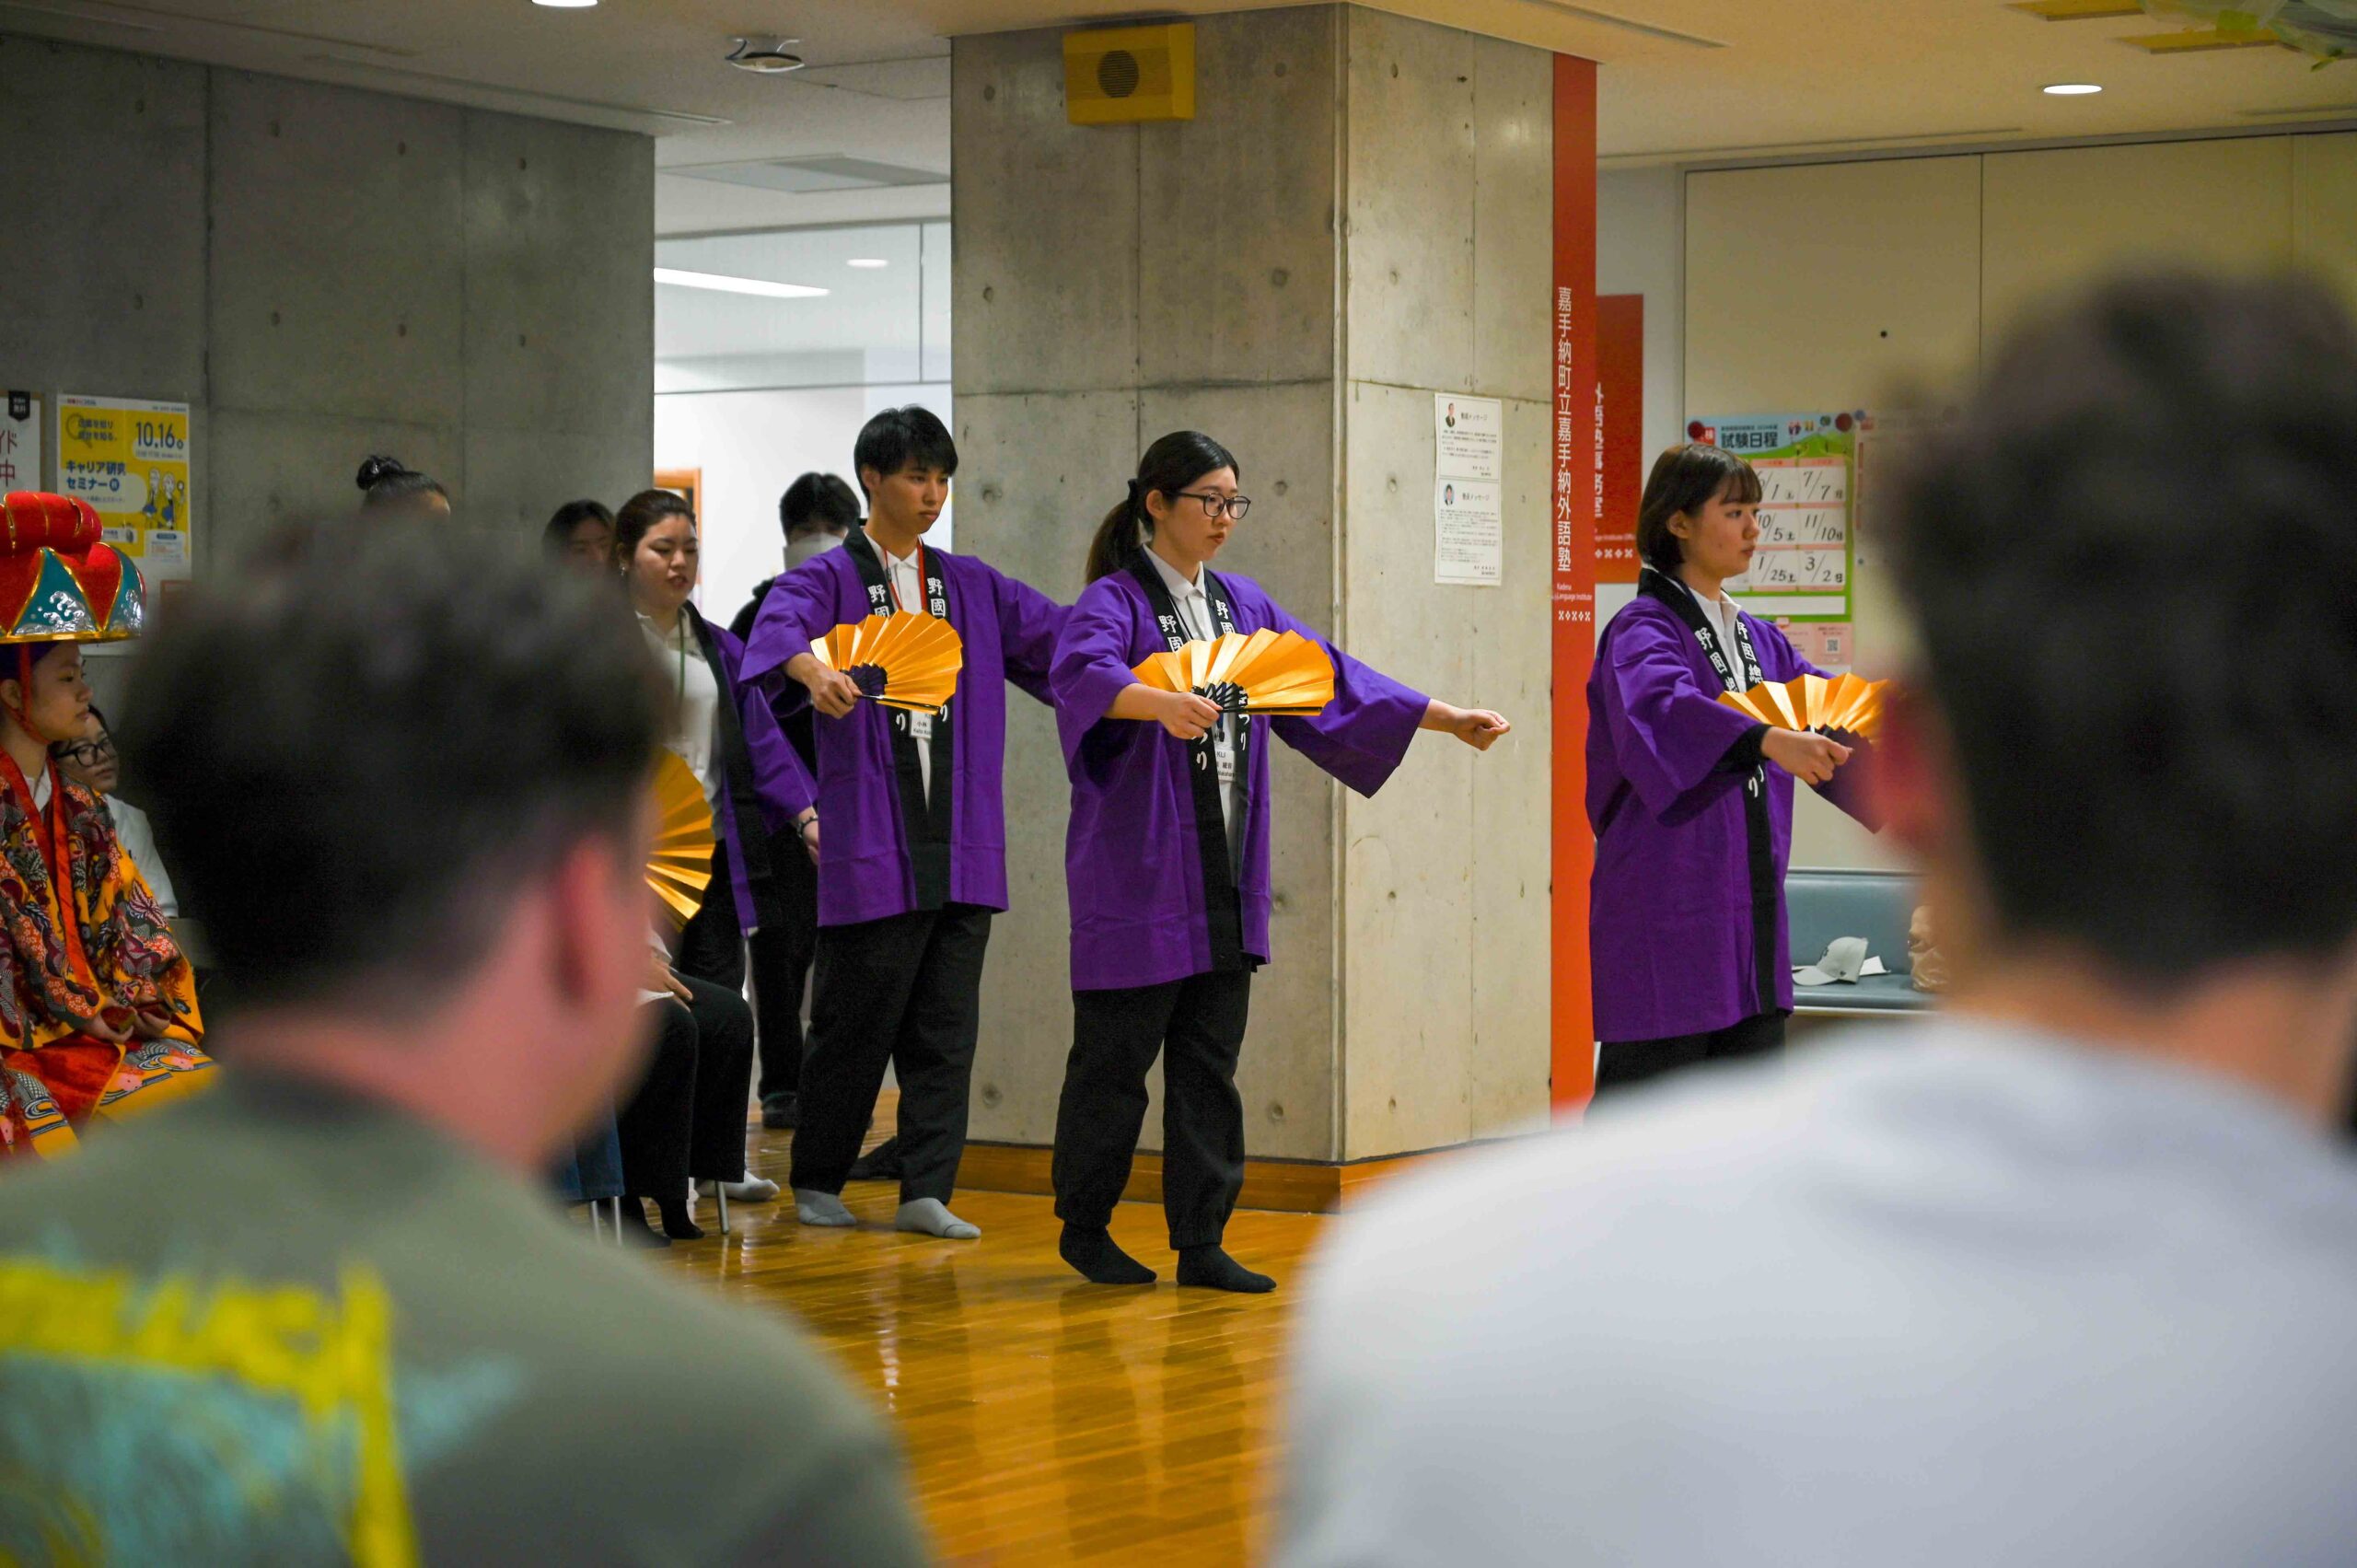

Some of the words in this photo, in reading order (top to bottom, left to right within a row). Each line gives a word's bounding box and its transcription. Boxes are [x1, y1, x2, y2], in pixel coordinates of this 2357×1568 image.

[136, 422, 176, 449] 10.16
[1558, 286, 1572, 572] 嘉手納町立嘉手納外語塾
[1721, 432, 1778, 448] 試験日程
[0, 459, 15, 487] 中
[66, 460, 126, 476] キャリア研究
[67, 477, 108, 491] セミナー
[927, 577, 946, 618] 野國
